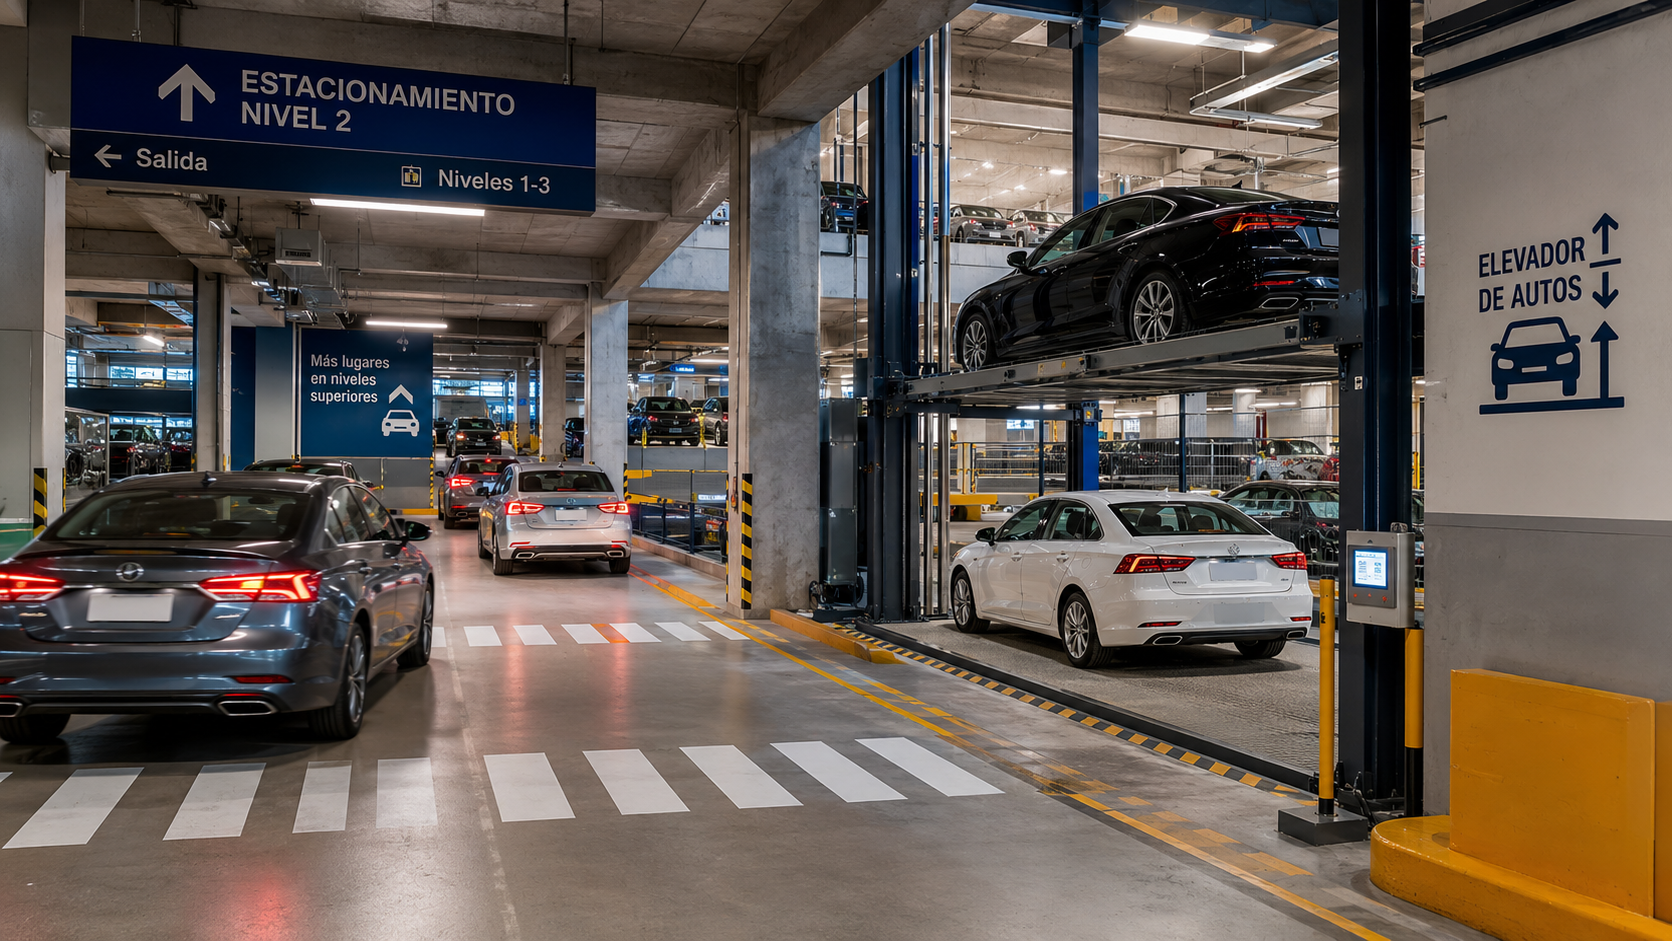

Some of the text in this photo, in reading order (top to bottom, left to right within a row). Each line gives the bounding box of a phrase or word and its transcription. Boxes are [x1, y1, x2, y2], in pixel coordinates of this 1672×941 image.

[241, 69, 516, 117] ESTACIONAMIENTO
[241, 101, 352, 133] NIVEL 2
[136, 147, 208, 172] Salida
[438, 168, 551, 194] Niveles 1-3
[1479, 236, 1585, 278] ELEVADOR
[1479, 274, 1582, 313] DE AUTOS
[310, 354, 390, 371] Más lugares
[310, 372, 377, 386] en niveles
[310, 390, 378, 405] superiores
